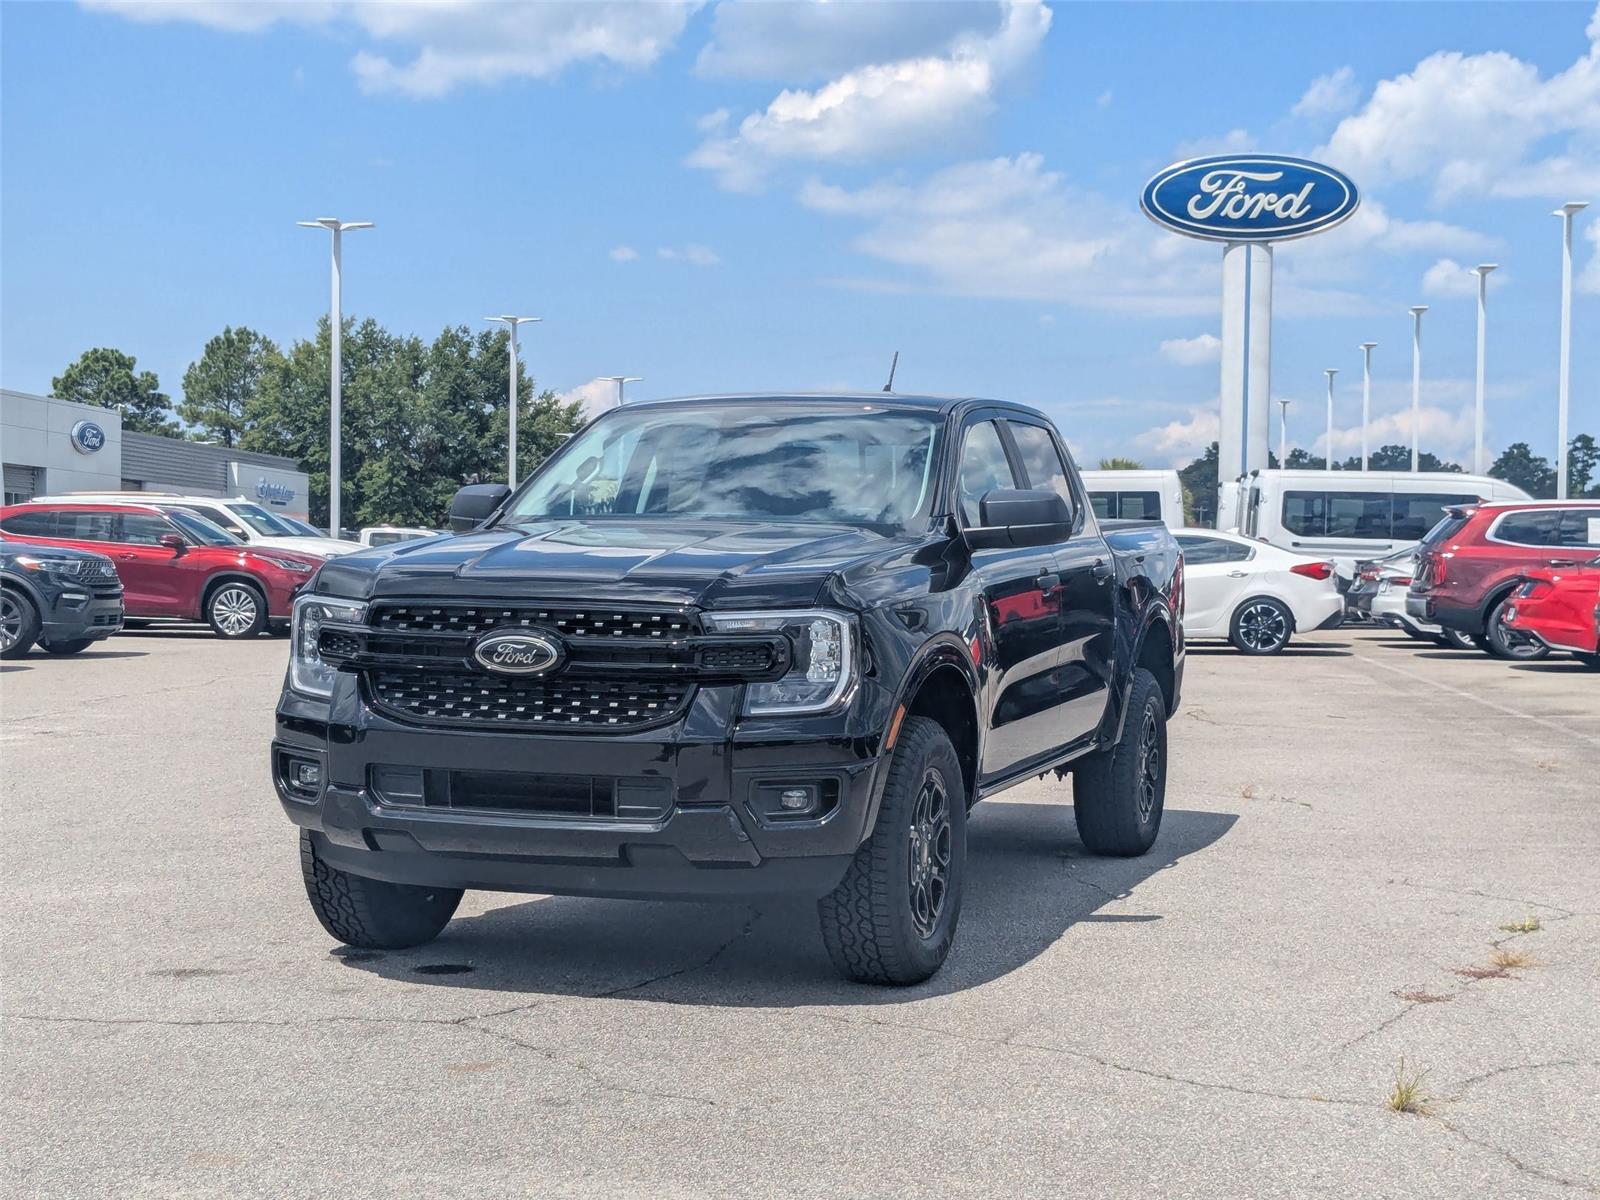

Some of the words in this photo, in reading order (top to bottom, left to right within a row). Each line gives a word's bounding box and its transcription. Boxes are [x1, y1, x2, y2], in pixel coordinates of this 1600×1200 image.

[1186, 169, 1316, 220] Ford
[83, 428, 101, 447] Ford
[492, 642, 537, 664] Ford
